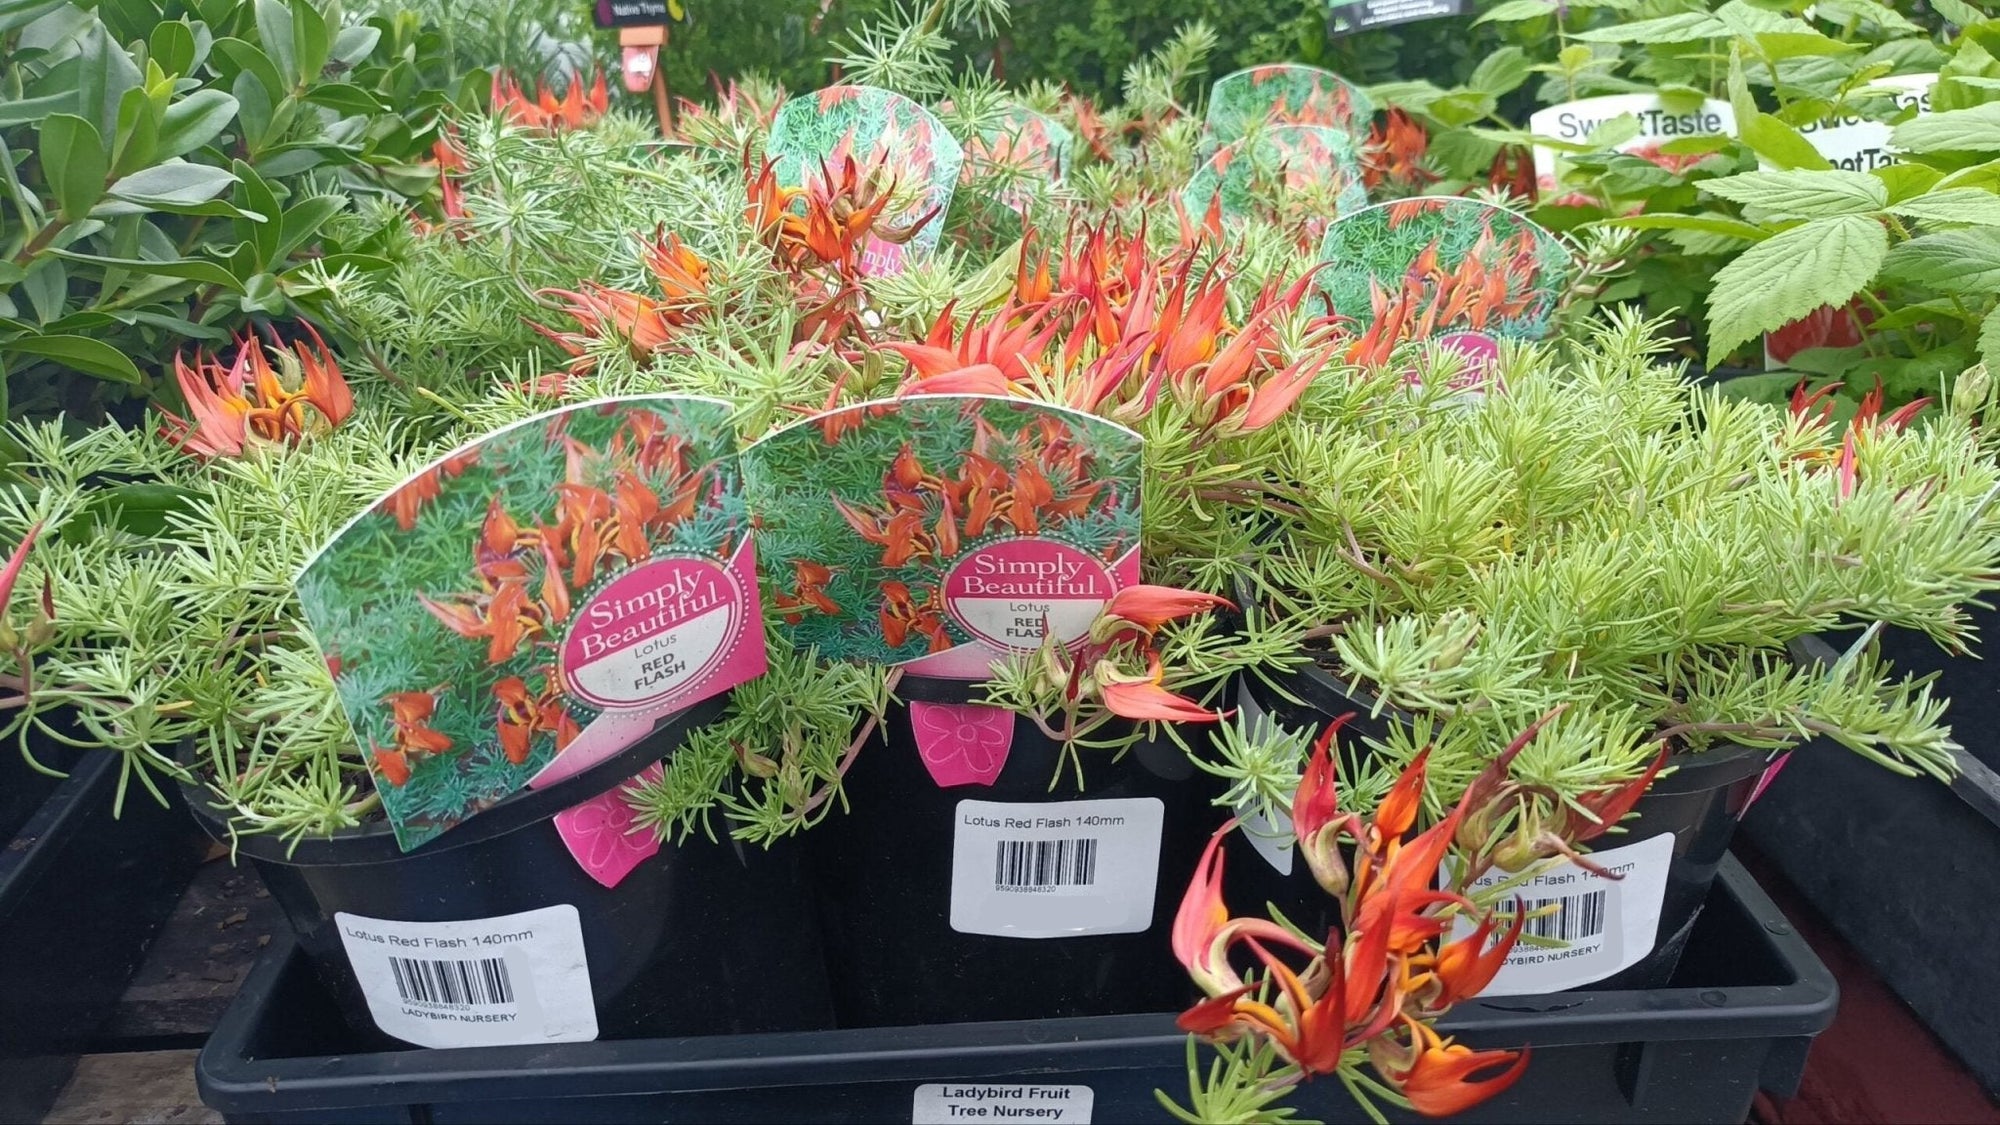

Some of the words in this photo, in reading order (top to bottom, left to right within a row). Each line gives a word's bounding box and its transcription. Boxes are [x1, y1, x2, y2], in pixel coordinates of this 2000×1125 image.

[1558, 110, 1722, 138] SwtTaste
[862, 246, 904, 274] mply
[974, 552, 1085, 580] Simply
[961, 574, 1096, 595] Beautiful
[589, 567, 703, 631] Simply
[1009, 602, 1050, 612] Lotus
[579, 580, 720, 660] Beautiful
[1014, 617, 1044, 627] RED
[1006, 627, 1044, 638] FLAS
[633, 632, 678, 660] Lotus
[641, 652, 675, 675] RED
[633, 660, 686, 690] FLASH
[963, 814, 1001, 828] Lotus
[1004, 817, 1032, 829] Red
[1036, 817, 1071, 829] Flash
[1076, 815, 1125, 827] 140mm
[1534, 872, 1576, 887] Flash
[345, 926, 386, 945] Lotus
[389, 935, 420, 948] Red
[424, 937, 467, 949] Flash
[472, 929, 534, 947] 140mm
[1502, 955, 1545, 966] DYBIRD
[1548, 944, 1601, 963] NURSERY
[401, 1007, 458, 1021] LADYBIRD
[460, 1013, 518, 1023] NURSERY
[942, 1086, 1023, 1101] Ladybird
[1029, 1087, 1071, 1099] Fruit
[948, 1104, 988, 1116] Tree
[993, 1104, 1064, 1120] Nursery
